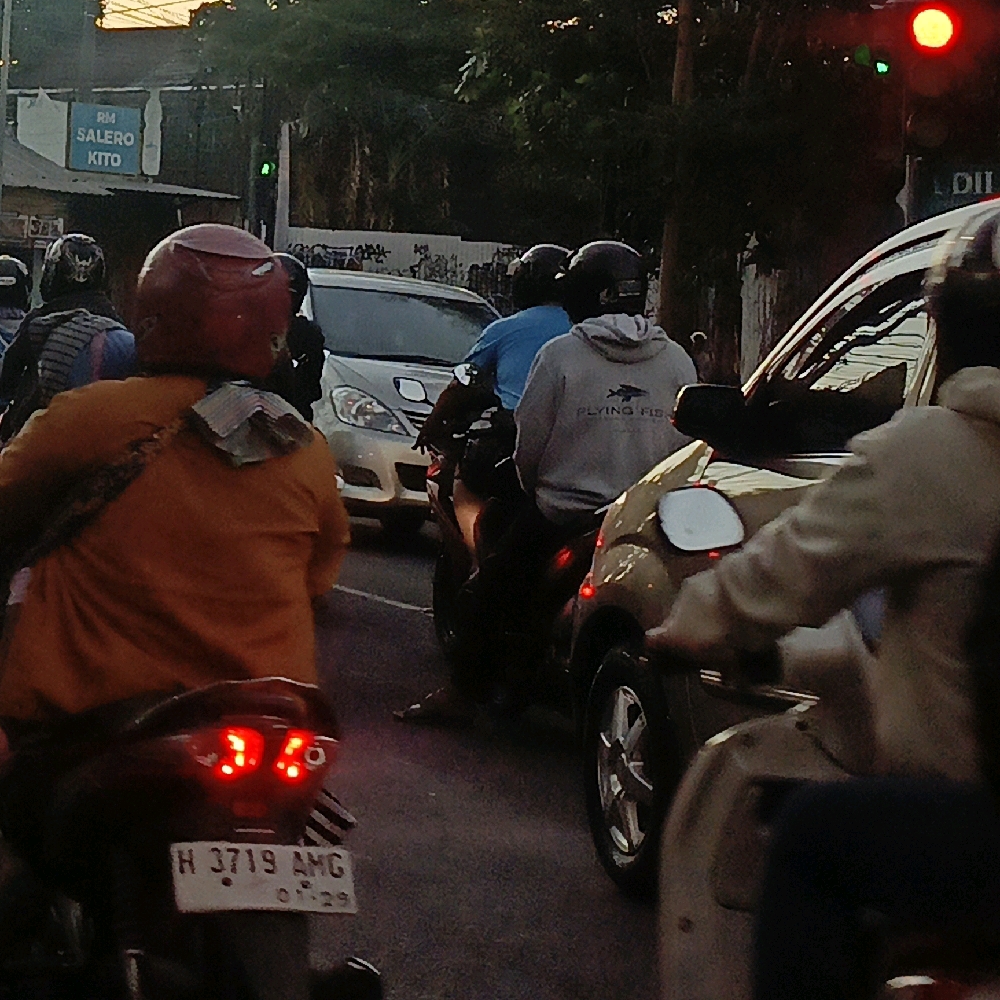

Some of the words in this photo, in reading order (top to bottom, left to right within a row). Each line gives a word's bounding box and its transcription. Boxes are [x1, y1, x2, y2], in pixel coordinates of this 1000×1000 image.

[96, 111, 117, 125] RM
[76, 127, 135, 147] SALERO
[87, 150, 122, 167] KITO
[576, 405, 635, 418] FLYING
[177, 848, 197, 875] H
[209, 846, 278, 875] 3719
[292, 850, 346, 879] AMG
